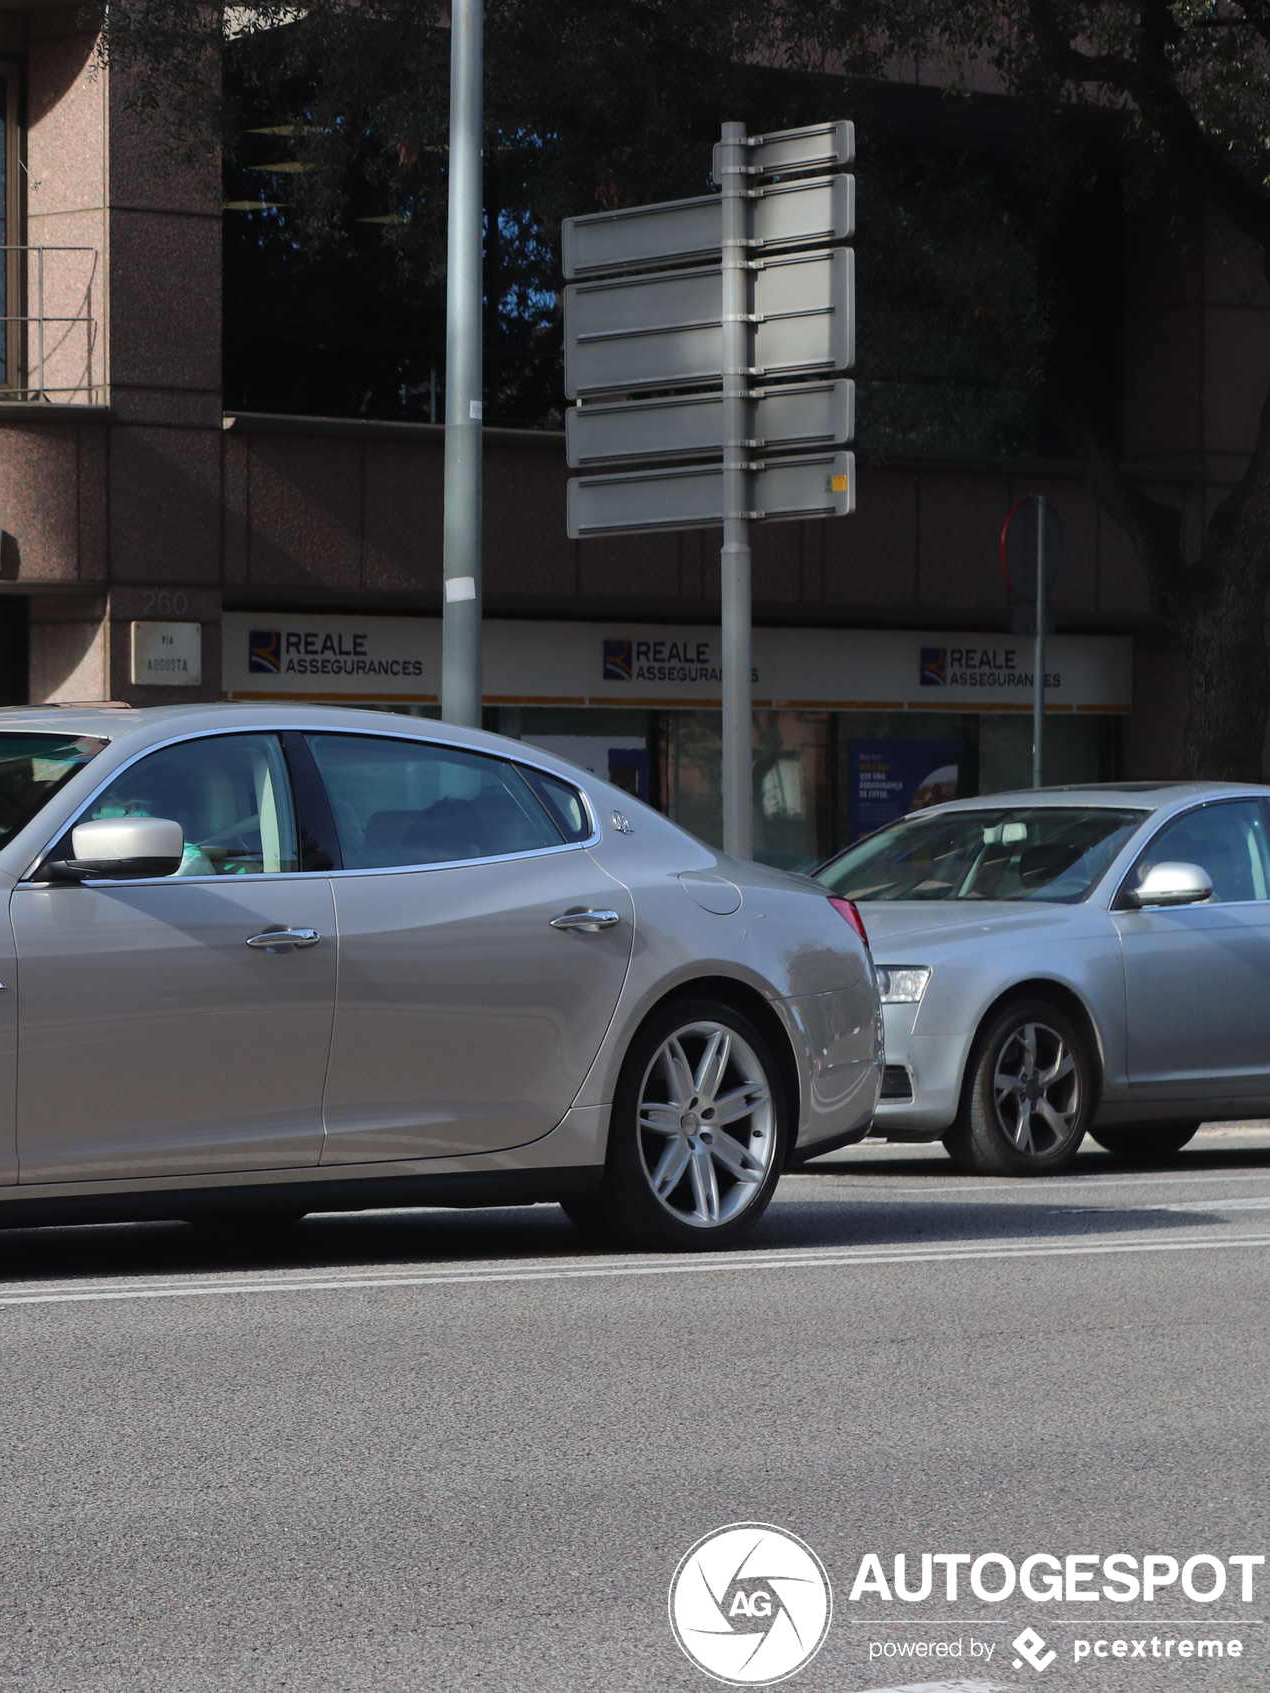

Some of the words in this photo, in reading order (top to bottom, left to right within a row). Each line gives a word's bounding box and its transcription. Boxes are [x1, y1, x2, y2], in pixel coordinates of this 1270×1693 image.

[143, 591, 188, 616] 260
[162, 635, 174, 645] VIA
[285, 632, 368, 656] REALE
[636, 641, 710, 663] REALE
[950, 649, 1017, 669] REALE
[147, 658, 188, 672] AUGUSTA
[285, 659, 423, 676] ASSEGURANCES
[636, 666, 759, 682] ASSEGURAS
[950, 672, 1061, 687] ASSEGURANES
